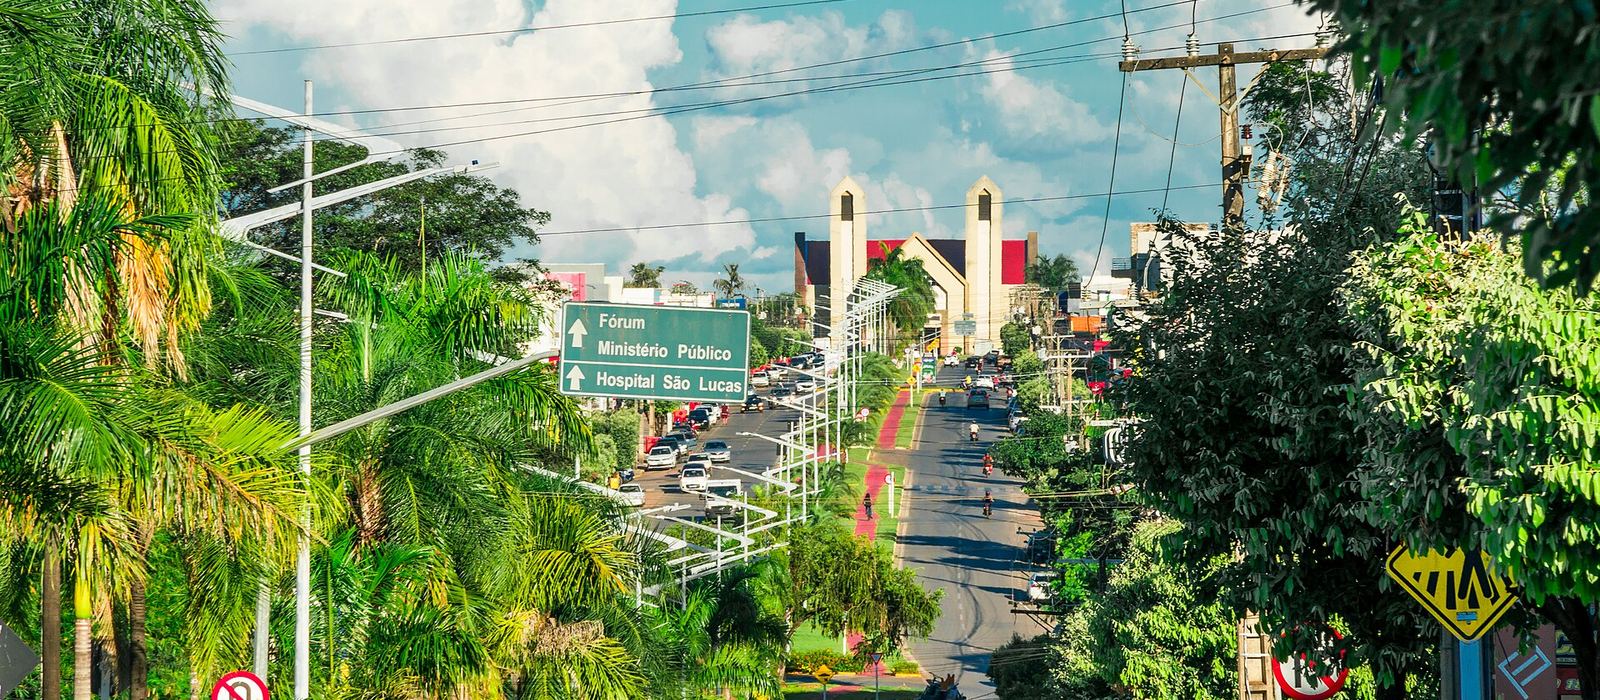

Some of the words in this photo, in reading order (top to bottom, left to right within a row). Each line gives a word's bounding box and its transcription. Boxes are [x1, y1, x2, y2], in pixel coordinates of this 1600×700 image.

[599, 313, 645, 330] Fórum
[598, 340, 668, 358] Ministério
[677, 343, 732, 361] Público
[596, 371, 655, 390] Hospital
[663, 374, 690, 390] São
[699, 376, 742, 393] Lucas
